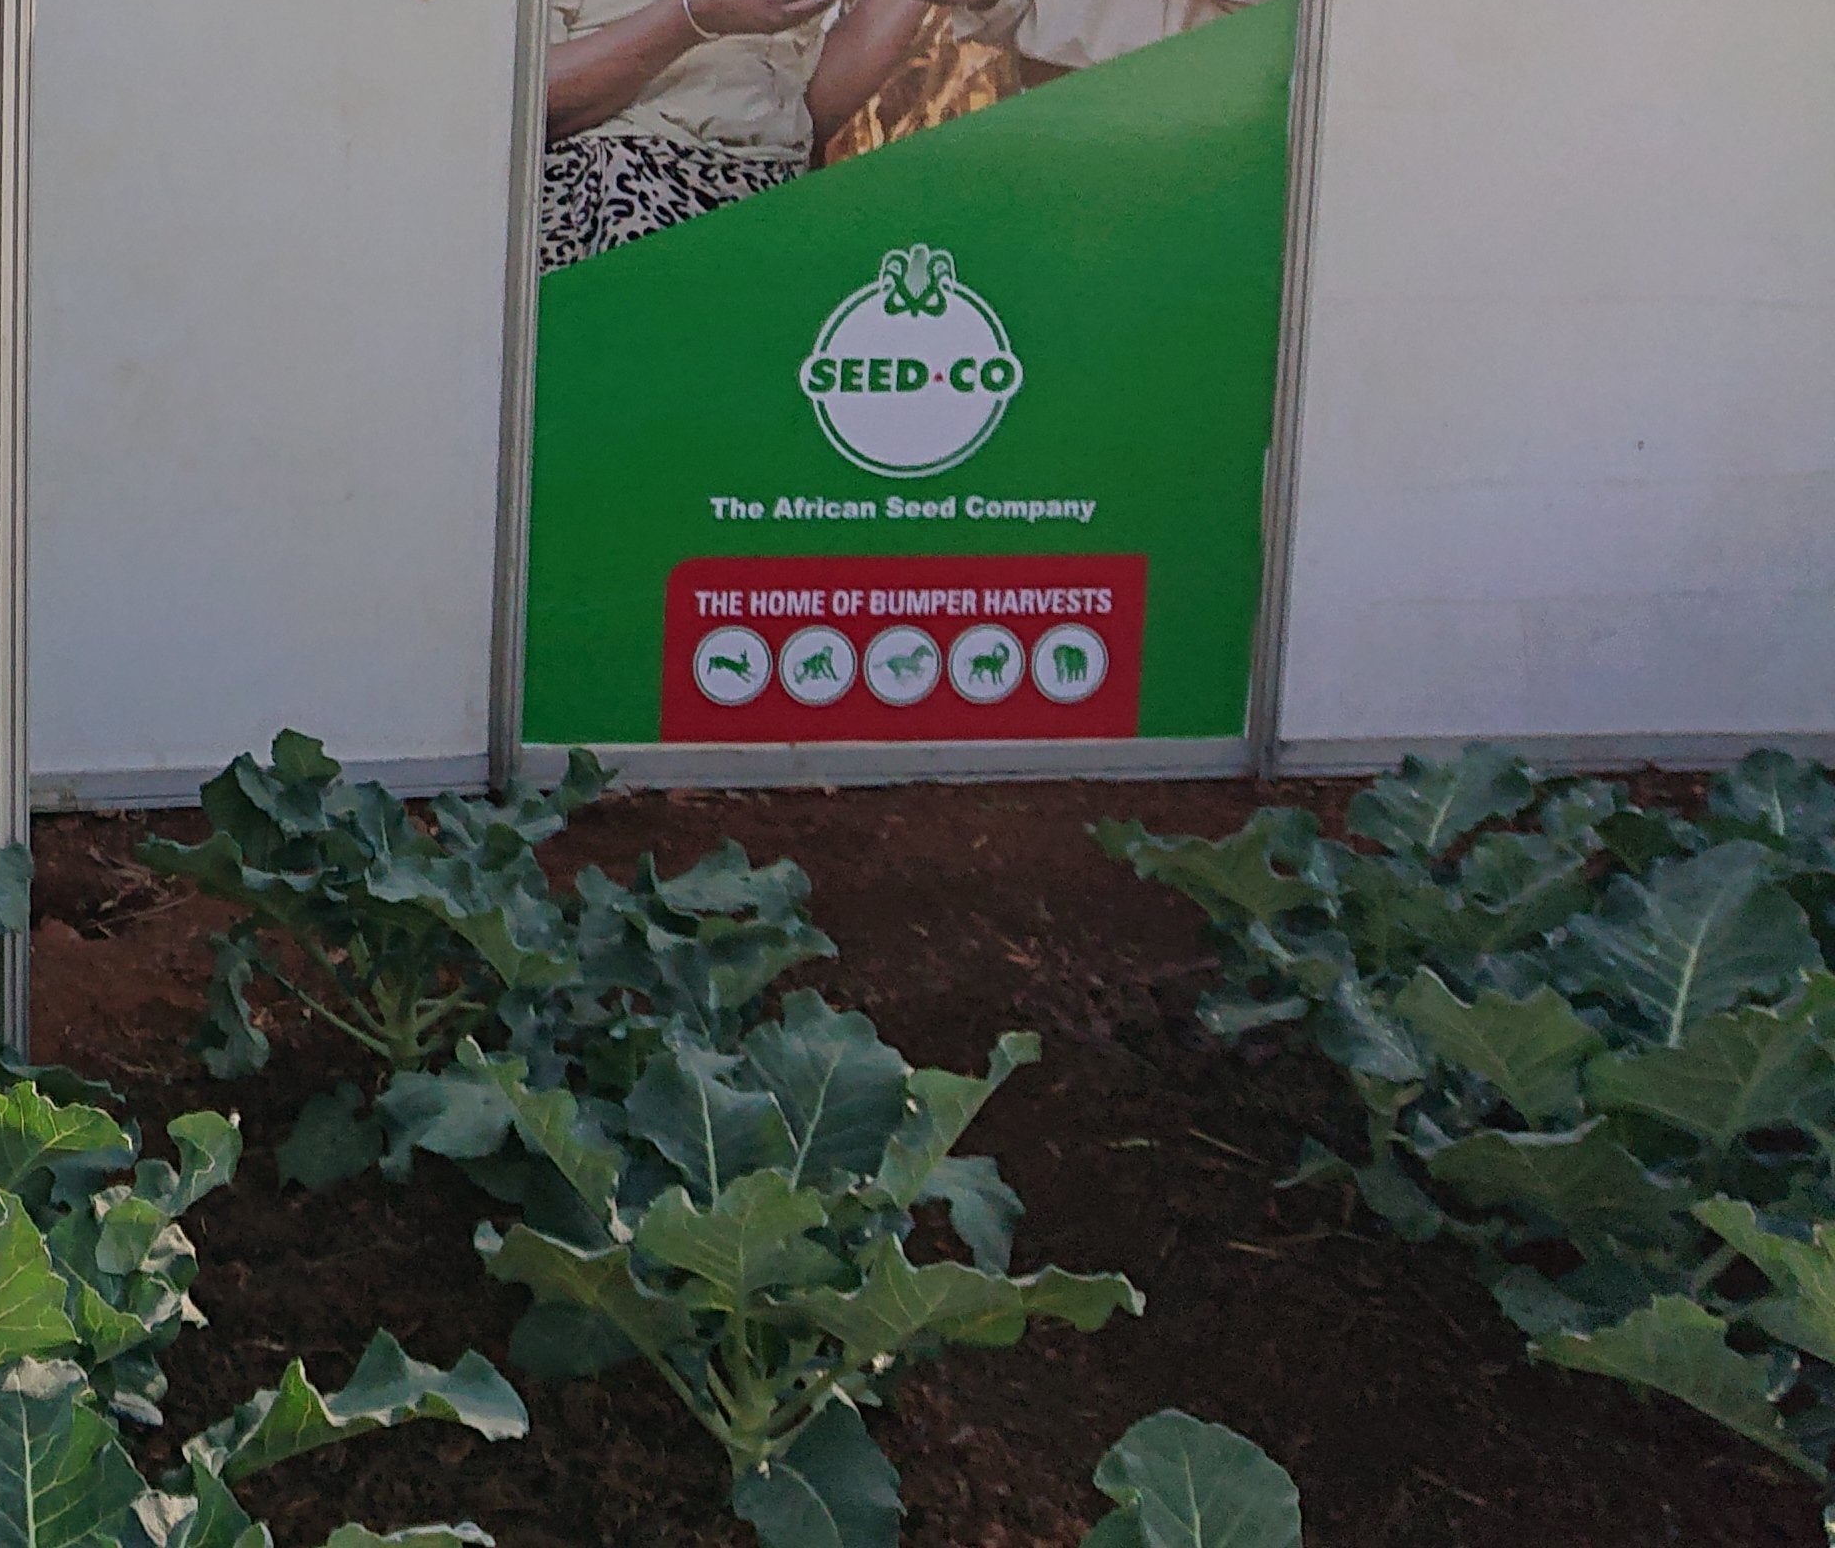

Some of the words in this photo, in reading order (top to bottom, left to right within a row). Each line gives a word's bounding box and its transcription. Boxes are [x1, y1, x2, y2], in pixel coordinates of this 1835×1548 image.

[709, 496, 766, 520] The
[773, 496, 877, 519] African
[885, 495, 957, 519] Seed
[964, 494, 1097, 523] Company
[696, 592, 741, 614] THE
[751, 591, 824, 614] HOME
[833, 591, 862, 614] OF
[870, 590, 976, 614] BUMPER
[985, 589, 1111, 613] HARVESTS
